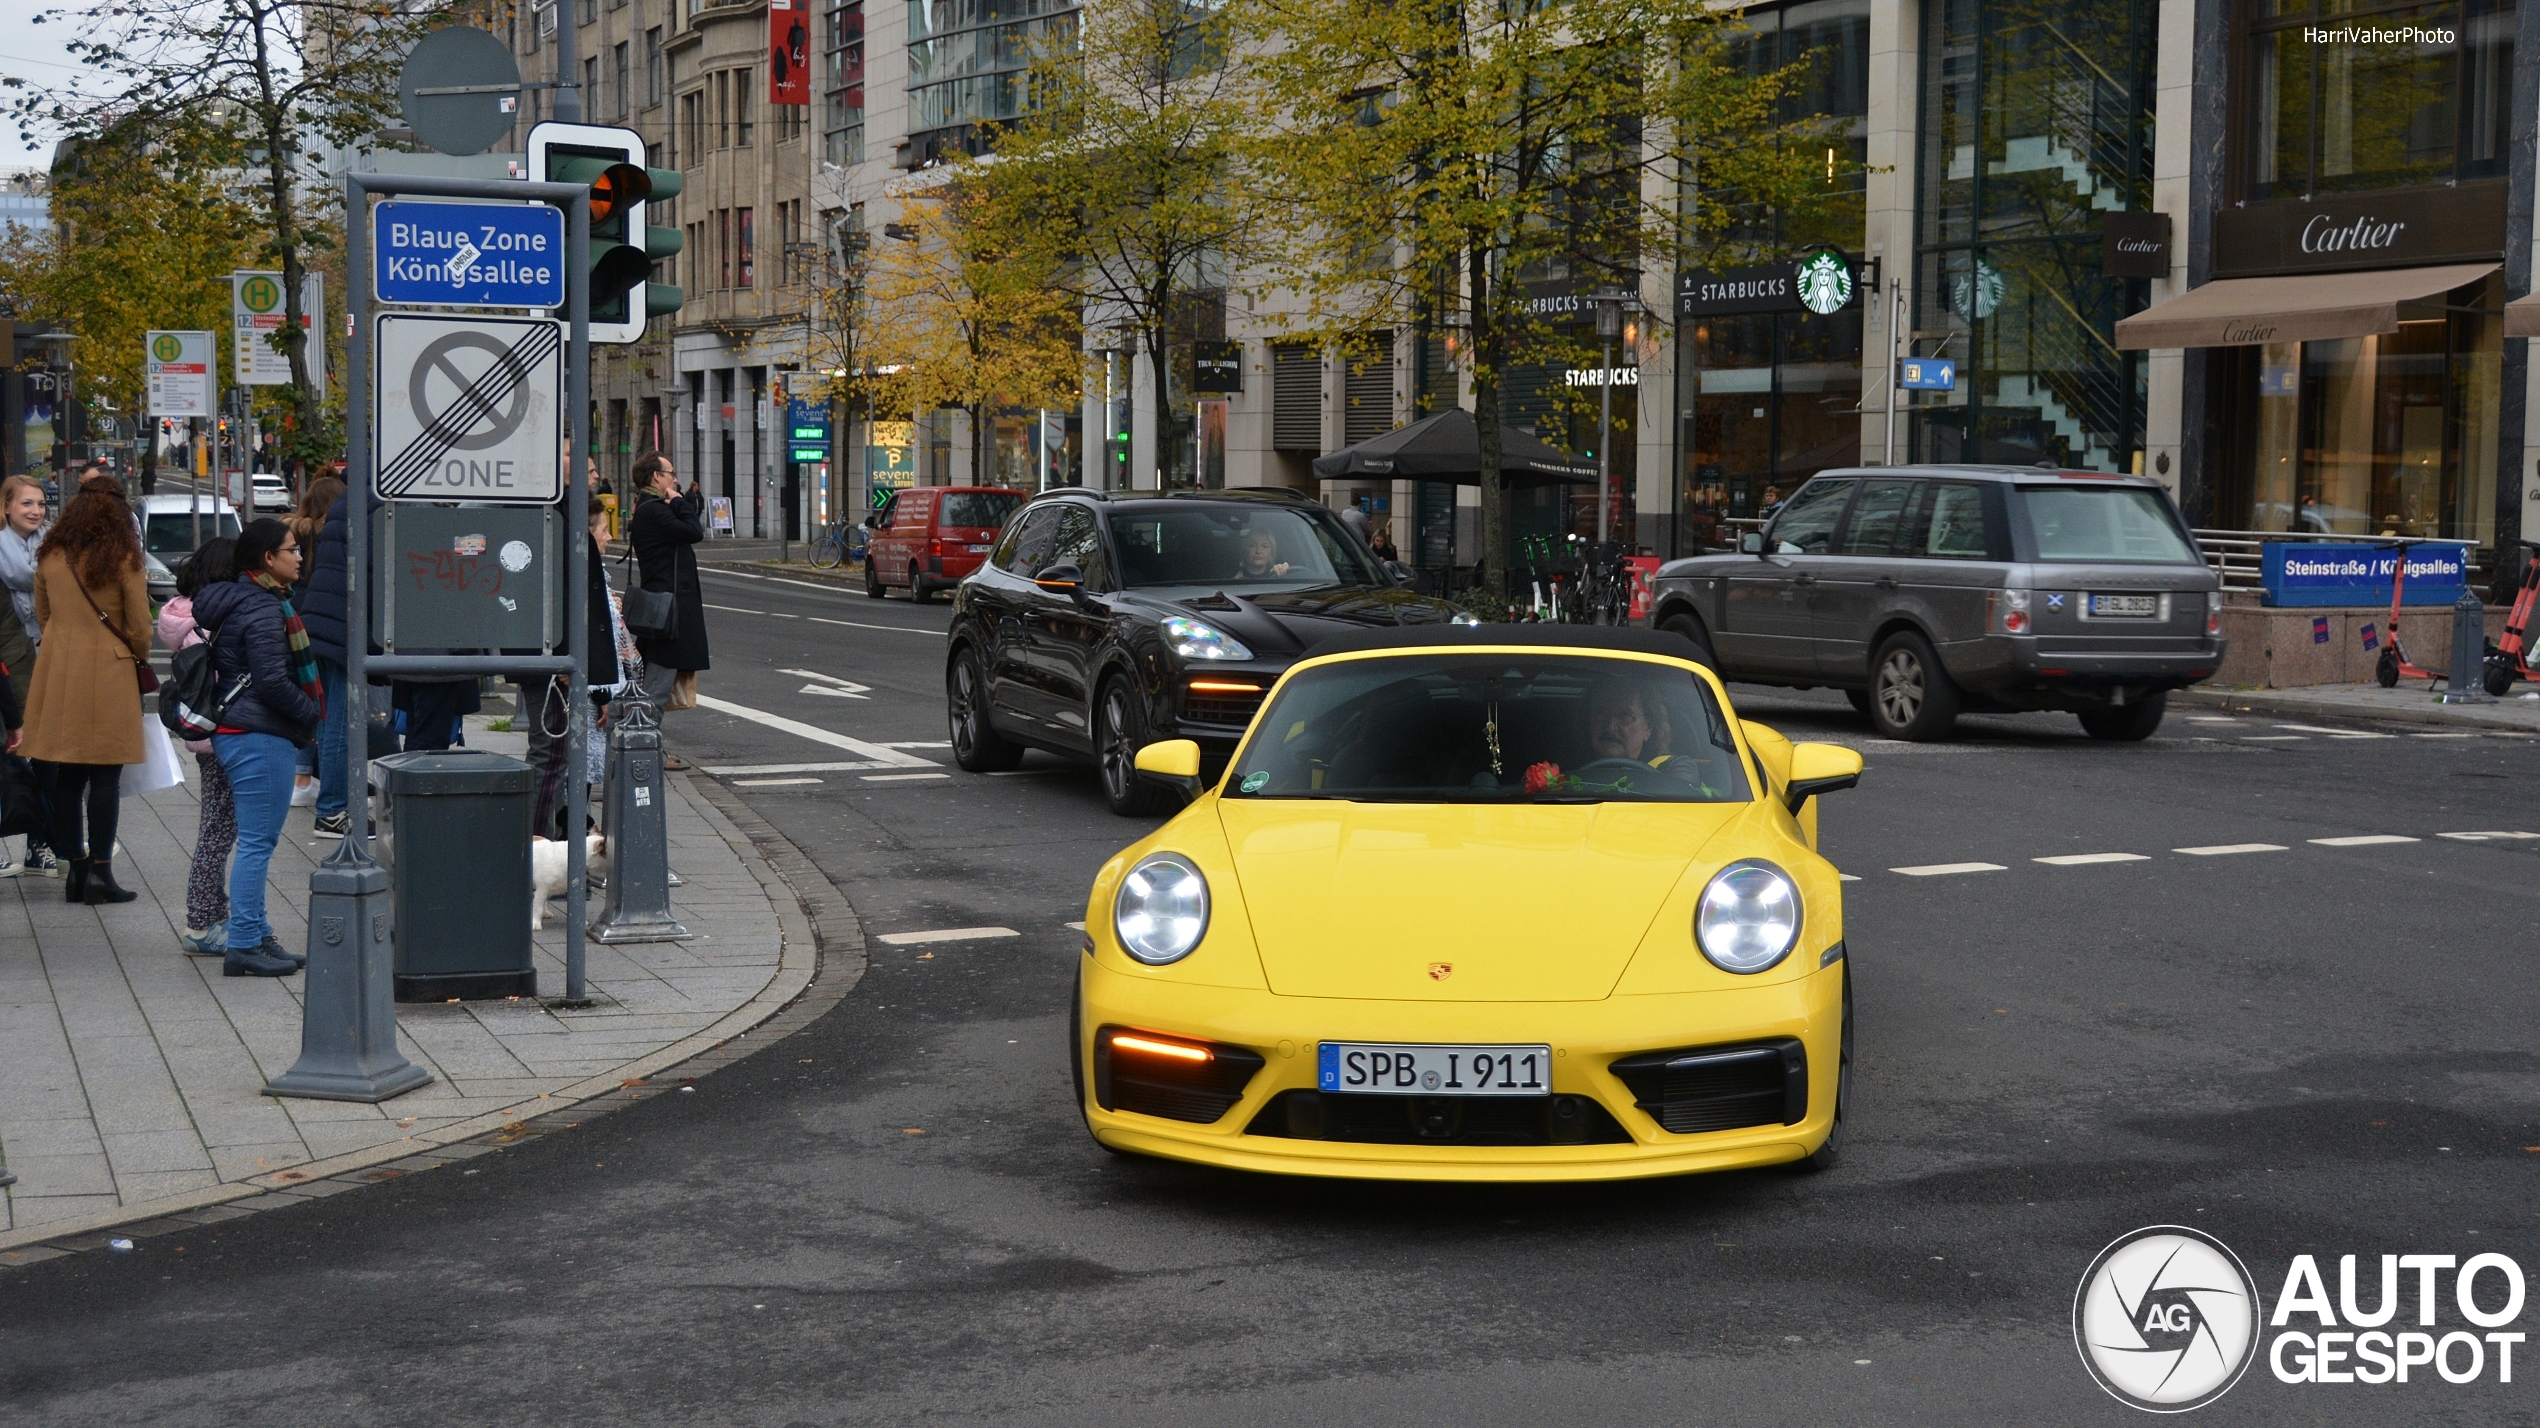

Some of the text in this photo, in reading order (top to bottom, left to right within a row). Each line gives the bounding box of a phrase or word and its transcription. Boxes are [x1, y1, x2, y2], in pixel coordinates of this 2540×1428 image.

[392, 223, 546, 252] Blaue Zone
[2117, 236, 2162, 253] Cartier
[2302, 214, 2404, 254] Cartier
[388, 256, 550, 288] Königsallee
[251, 284, 270, 305] H
[1702, 278, 1786, 301] STARBUCKS
[238, 316, 252, 326] 12
[2222, 319, 2276, 342] Cartier
[160, 340, 174, 356] H
[424, 459, 514, 488] ZONE
[2285, 559, 2366, 576] Steinstraße
[2370, 560, 2376, 576] /
[1326, 1072, 1334, 1082] D
[1346, 1051, 1541, 1088] SPB I 911
